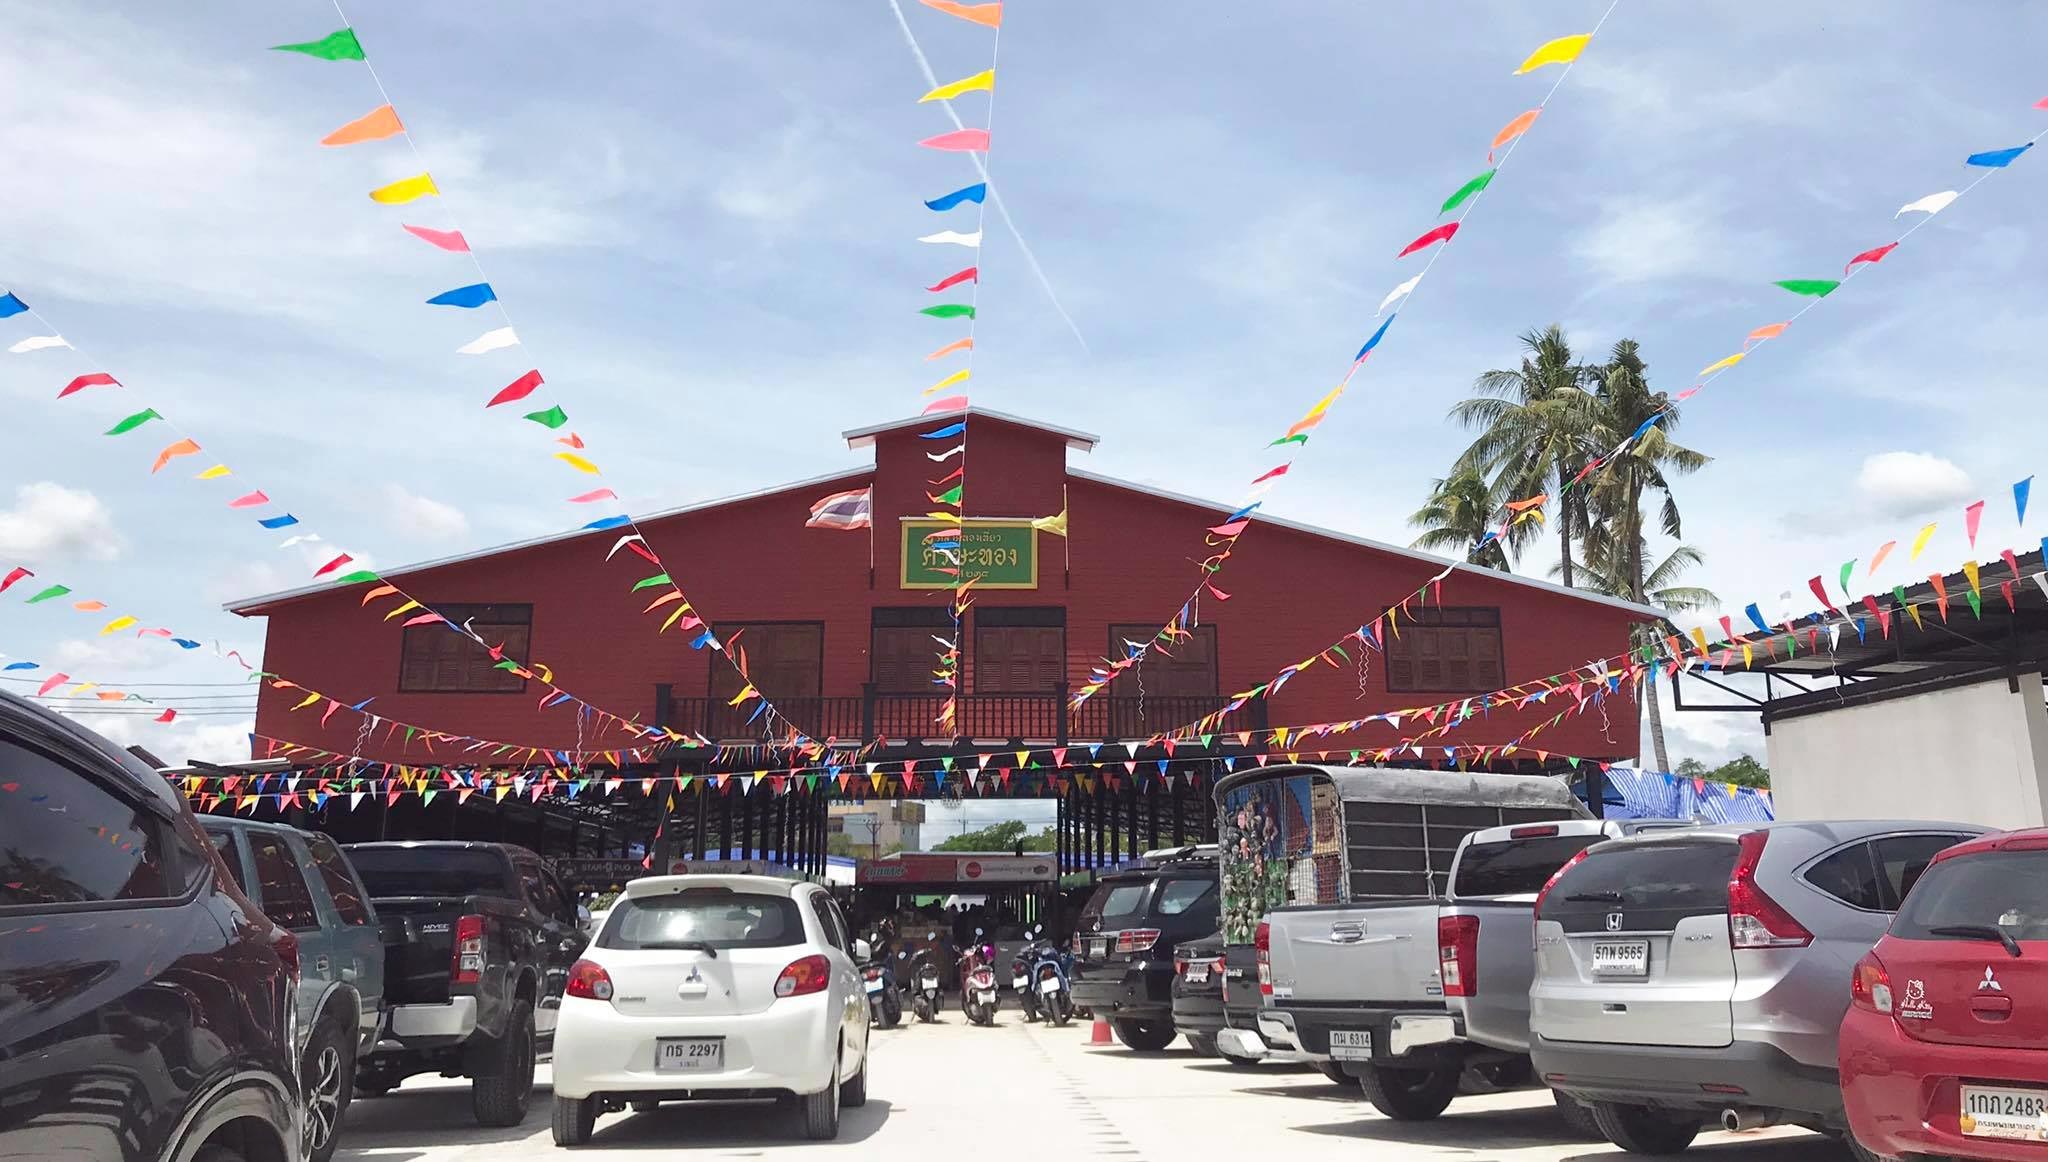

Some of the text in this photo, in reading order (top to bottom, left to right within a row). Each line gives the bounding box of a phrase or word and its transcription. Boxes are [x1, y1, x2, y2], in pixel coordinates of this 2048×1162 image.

[1618, 946, 1643, 960] 9565
[1350, 1032, 1370, 1046] 6314
[689, 1043, 718, 1057] 2297
[2004, 1096, 2044, 1117] 2483
